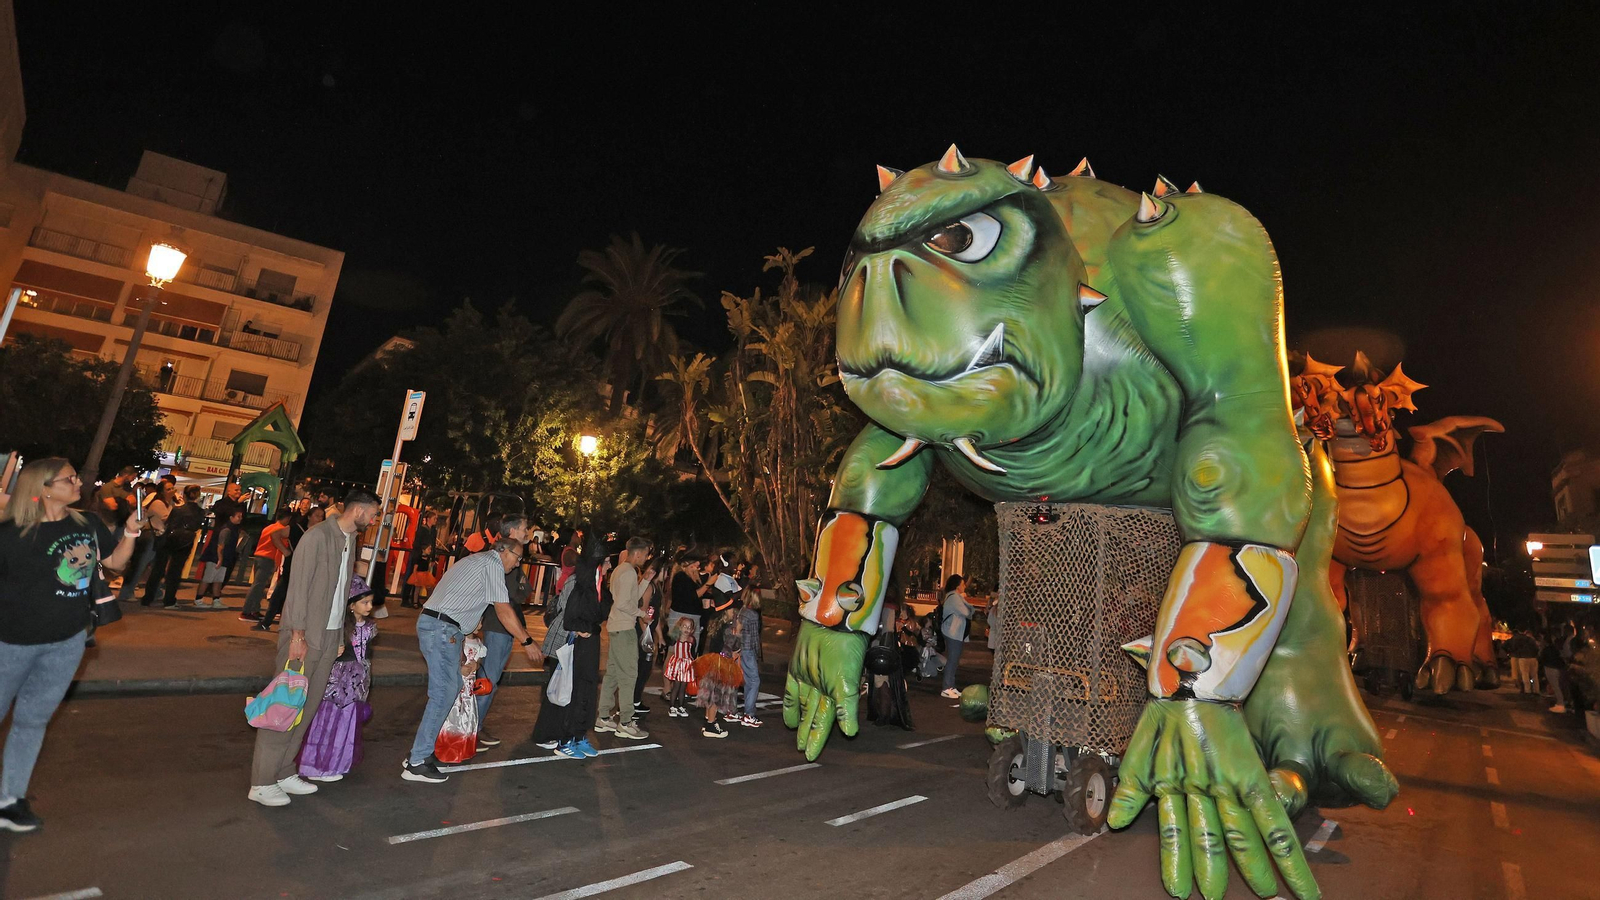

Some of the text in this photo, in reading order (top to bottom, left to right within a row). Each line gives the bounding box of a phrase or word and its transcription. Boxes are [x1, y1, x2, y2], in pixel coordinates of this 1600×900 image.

[207, 466, 218, 474] BAR
[47, 541, 59, 555] SAVE
[59, 534, 71, 542] THE
